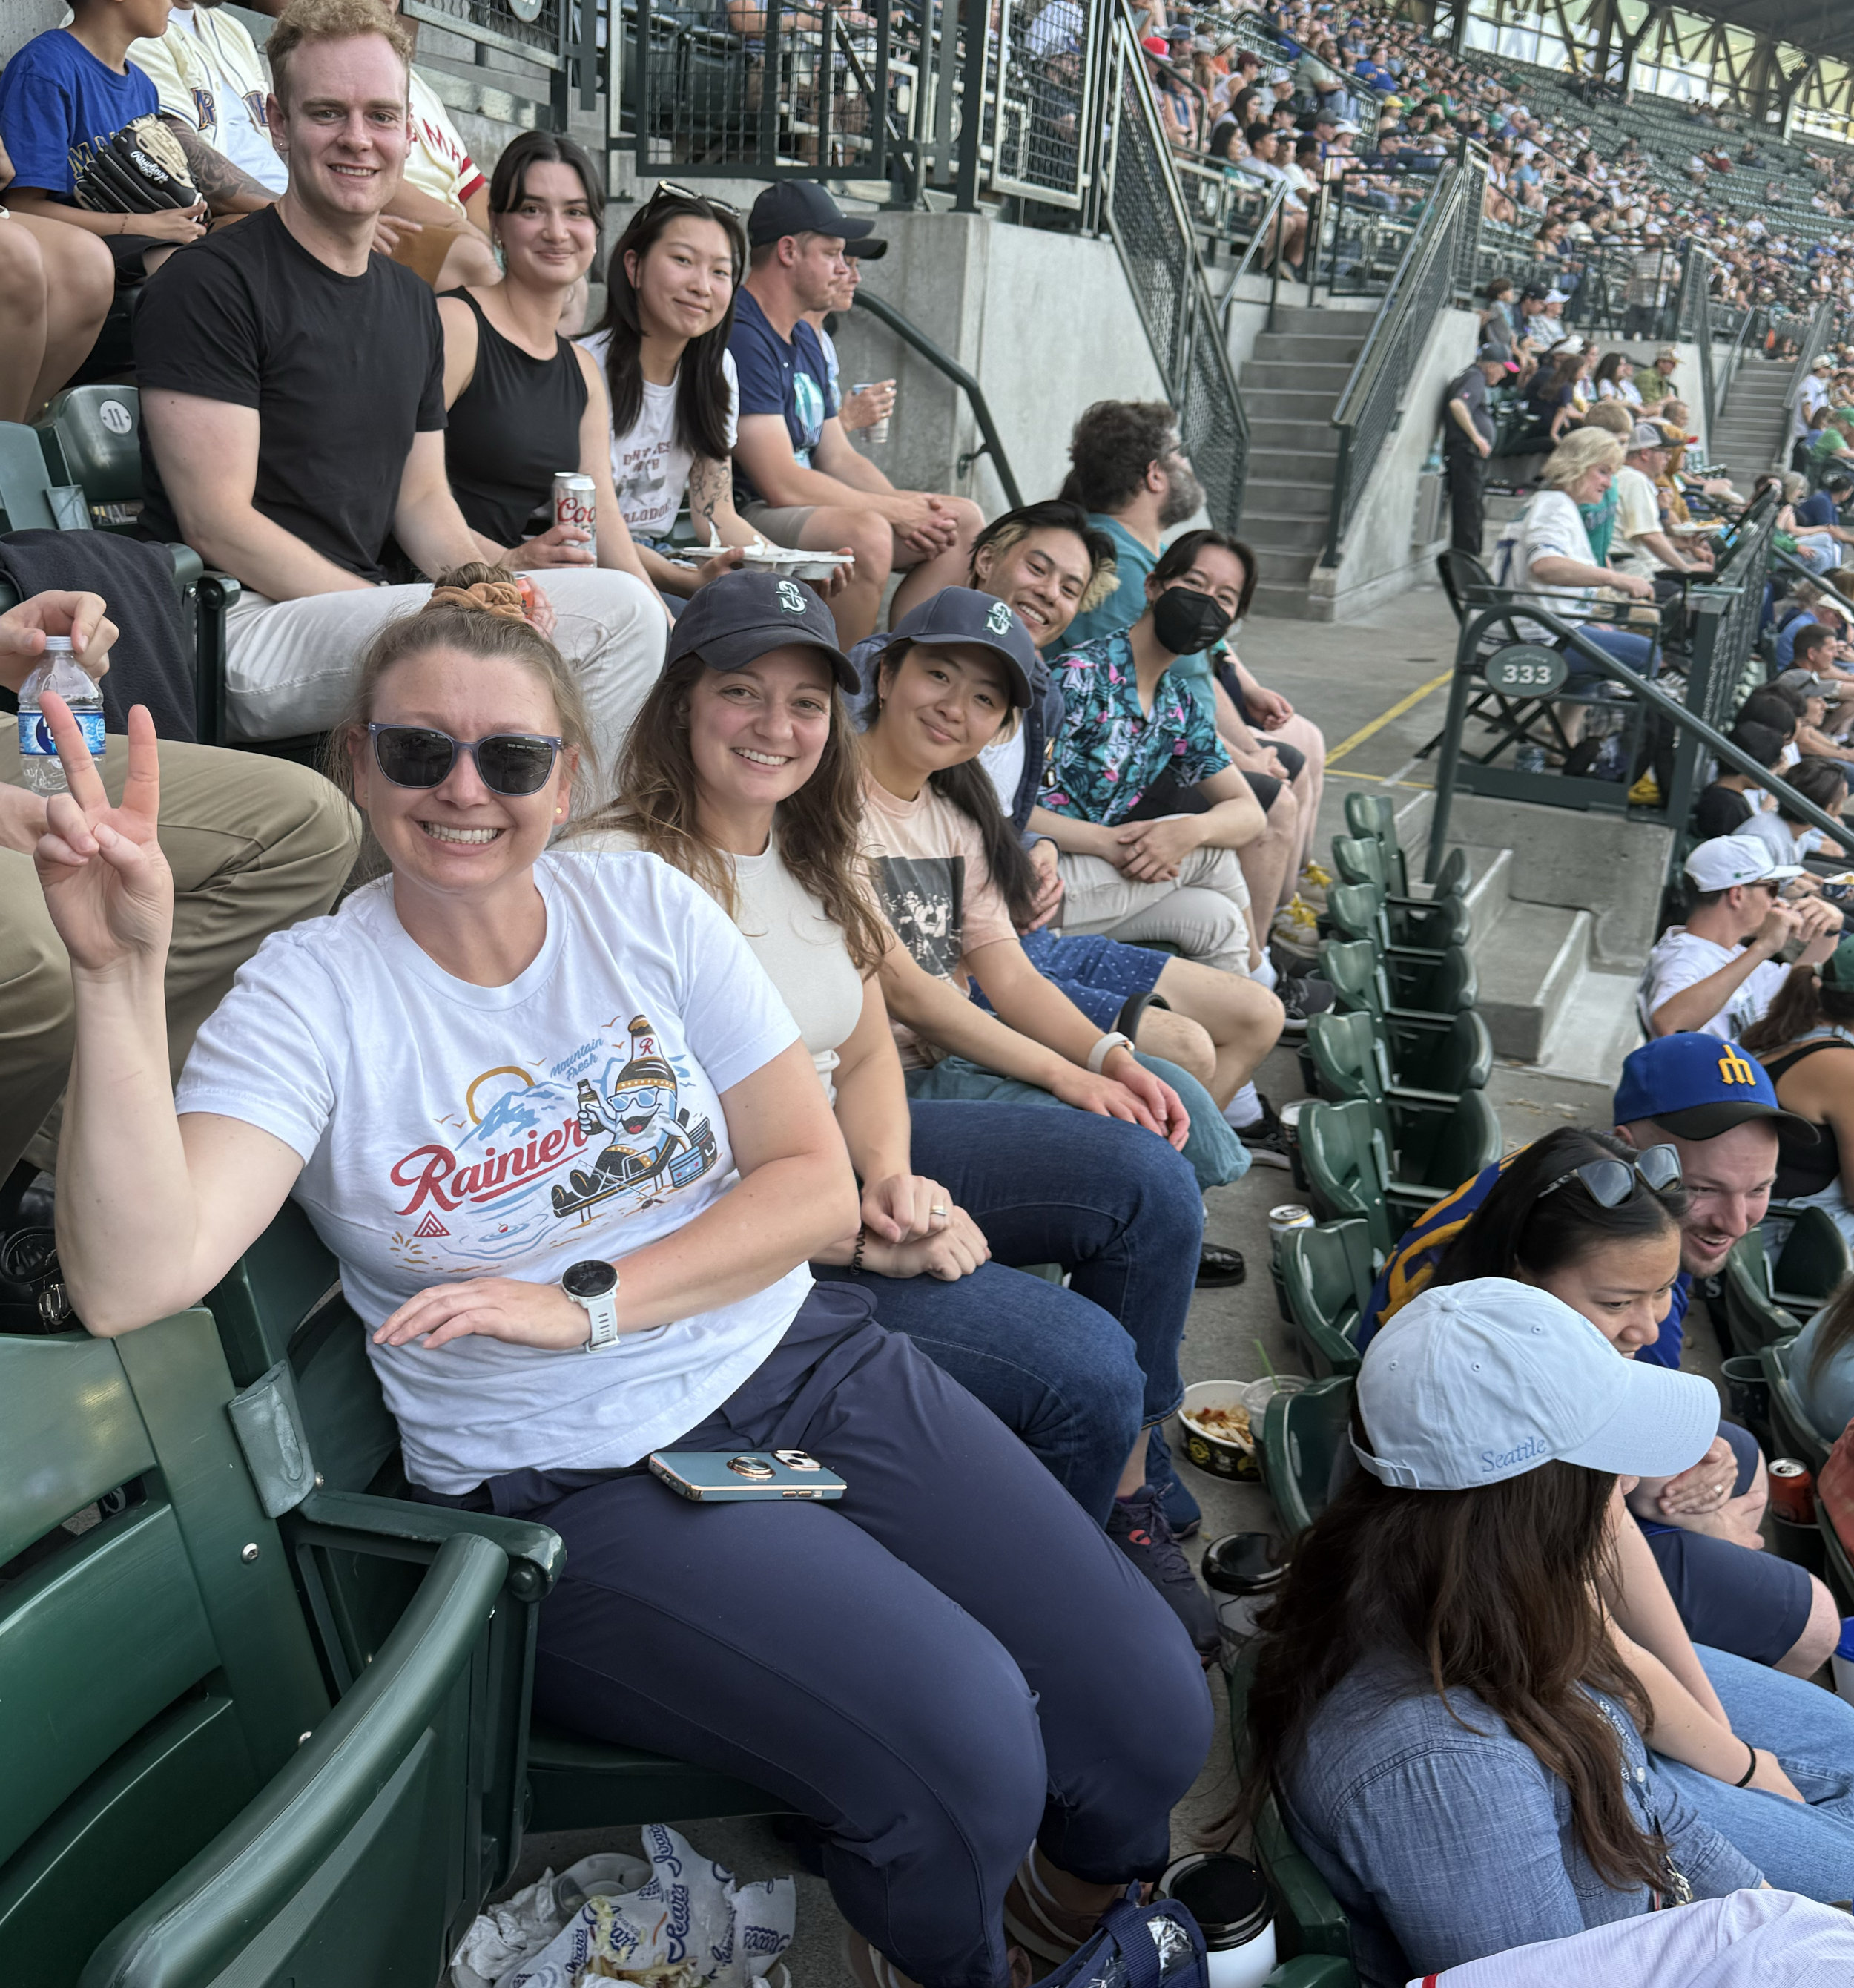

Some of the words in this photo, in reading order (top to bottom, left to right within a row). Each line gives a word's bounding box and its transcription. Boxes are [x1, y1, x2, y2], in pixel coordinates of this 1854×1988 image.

[130, 150, 169, 184] Rawlings
[108, 408, 125, 427] 11
[1502, 664, 1551, 685] 333
[550, 1038, 604, 1079] Mountain
[639, 1037, 654, 1056] R
[567, 1053, 598, 1082] Fresh
[390, 1118, 589, 1215] Rainier
[1482, 1436, 1546, 1472] Seattle
